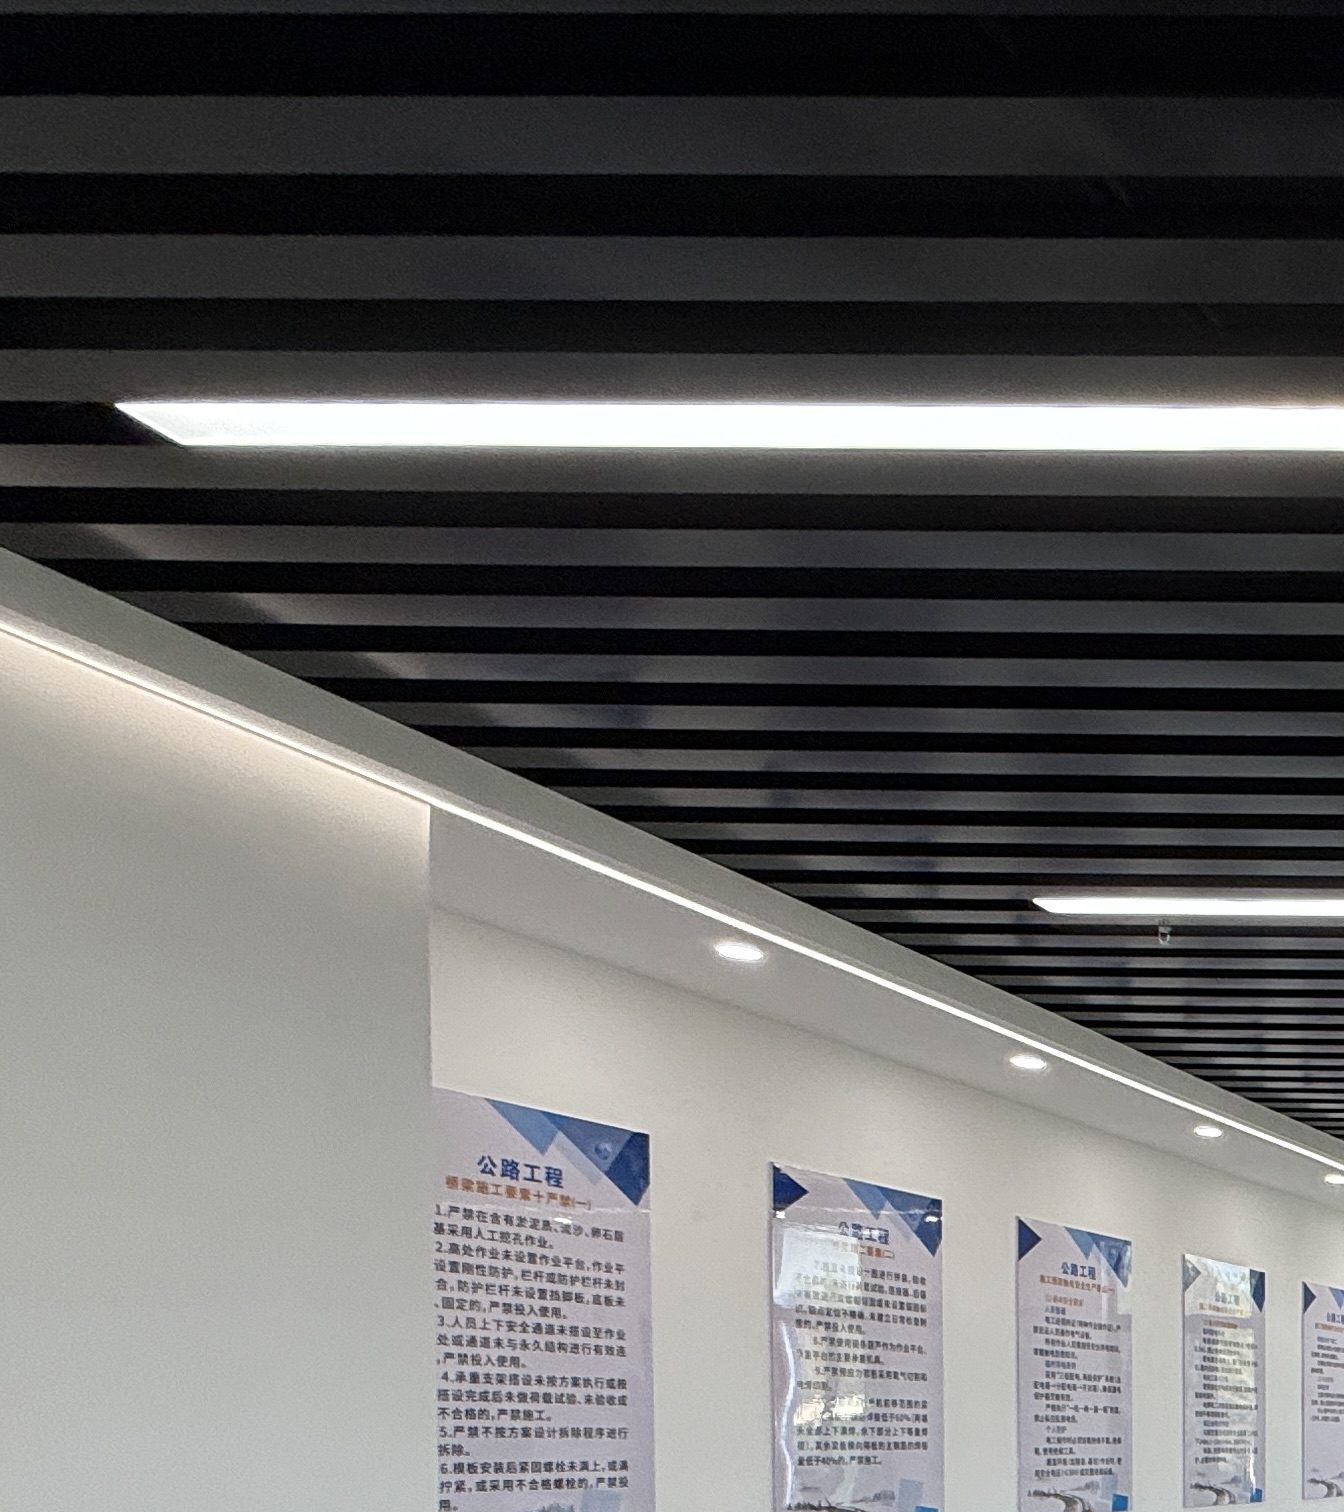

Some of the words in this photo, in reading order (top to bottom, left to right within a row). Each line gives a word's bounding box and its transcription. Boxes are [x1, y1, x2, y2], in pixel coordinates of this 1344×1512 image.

[477, 1155, 564, 1189] 公路工程
[1061, 1261, 1096, 1281] 公路工程
